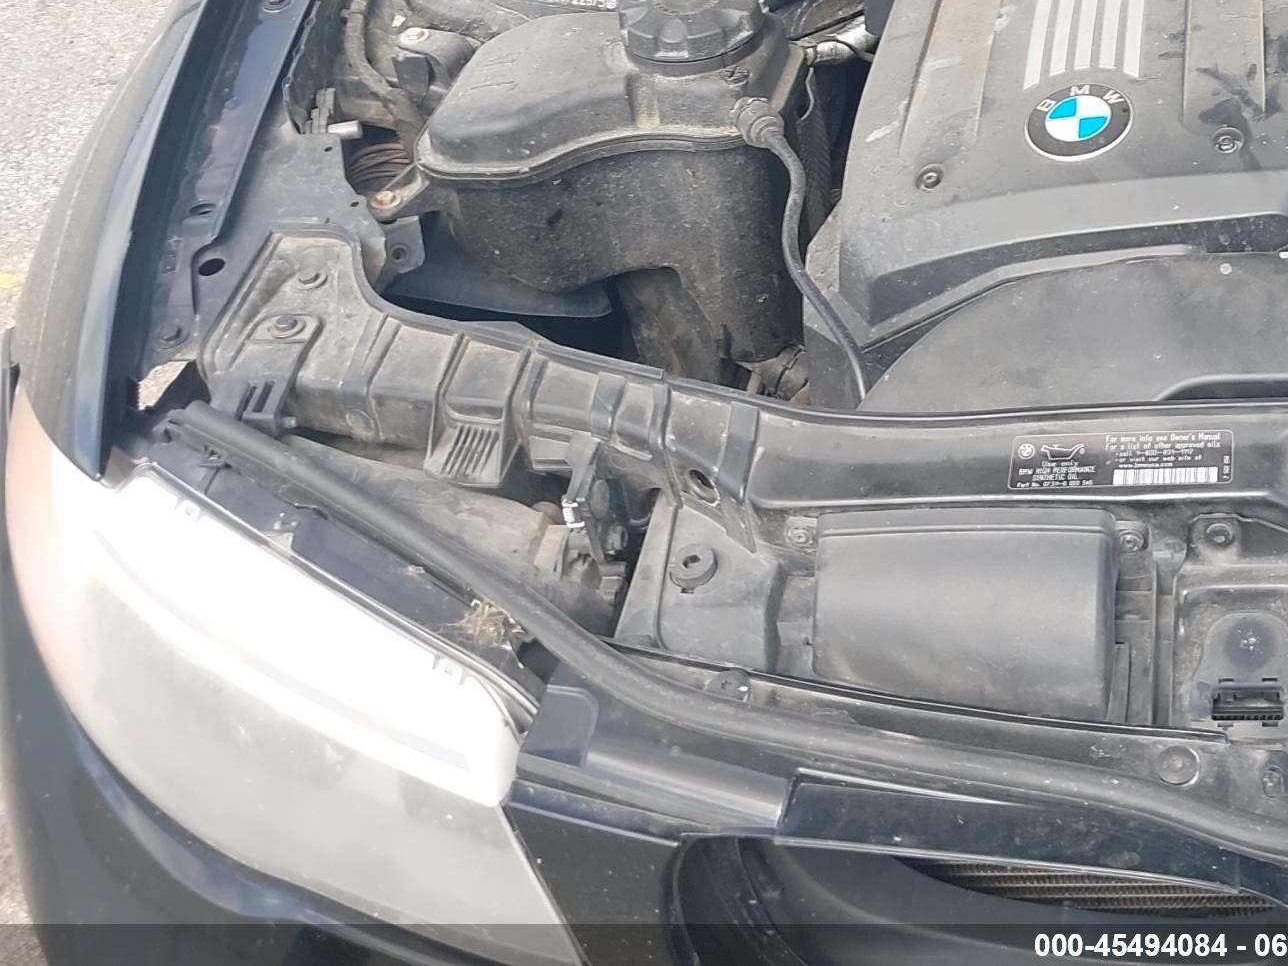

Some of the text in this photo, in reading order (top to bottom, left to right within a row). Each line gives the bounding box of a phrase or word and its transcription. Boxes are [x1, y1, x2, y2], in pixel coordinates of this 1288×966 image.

[1035, 84, 1126, 112] BMW
[1105, 435, 1117, 443] For
[1140, 434, 1153, 442] info
[1170, 433, 1195, 441] Owner's
[1198, 432, 1220, 440] Manual
[1128, 442, 1140, 450] list
[1042, 460, 1079, 468] Use only
[1036, 467, 1051, 475] HIGH
[1052, 465, 1097, 474] PERFORMANCE
